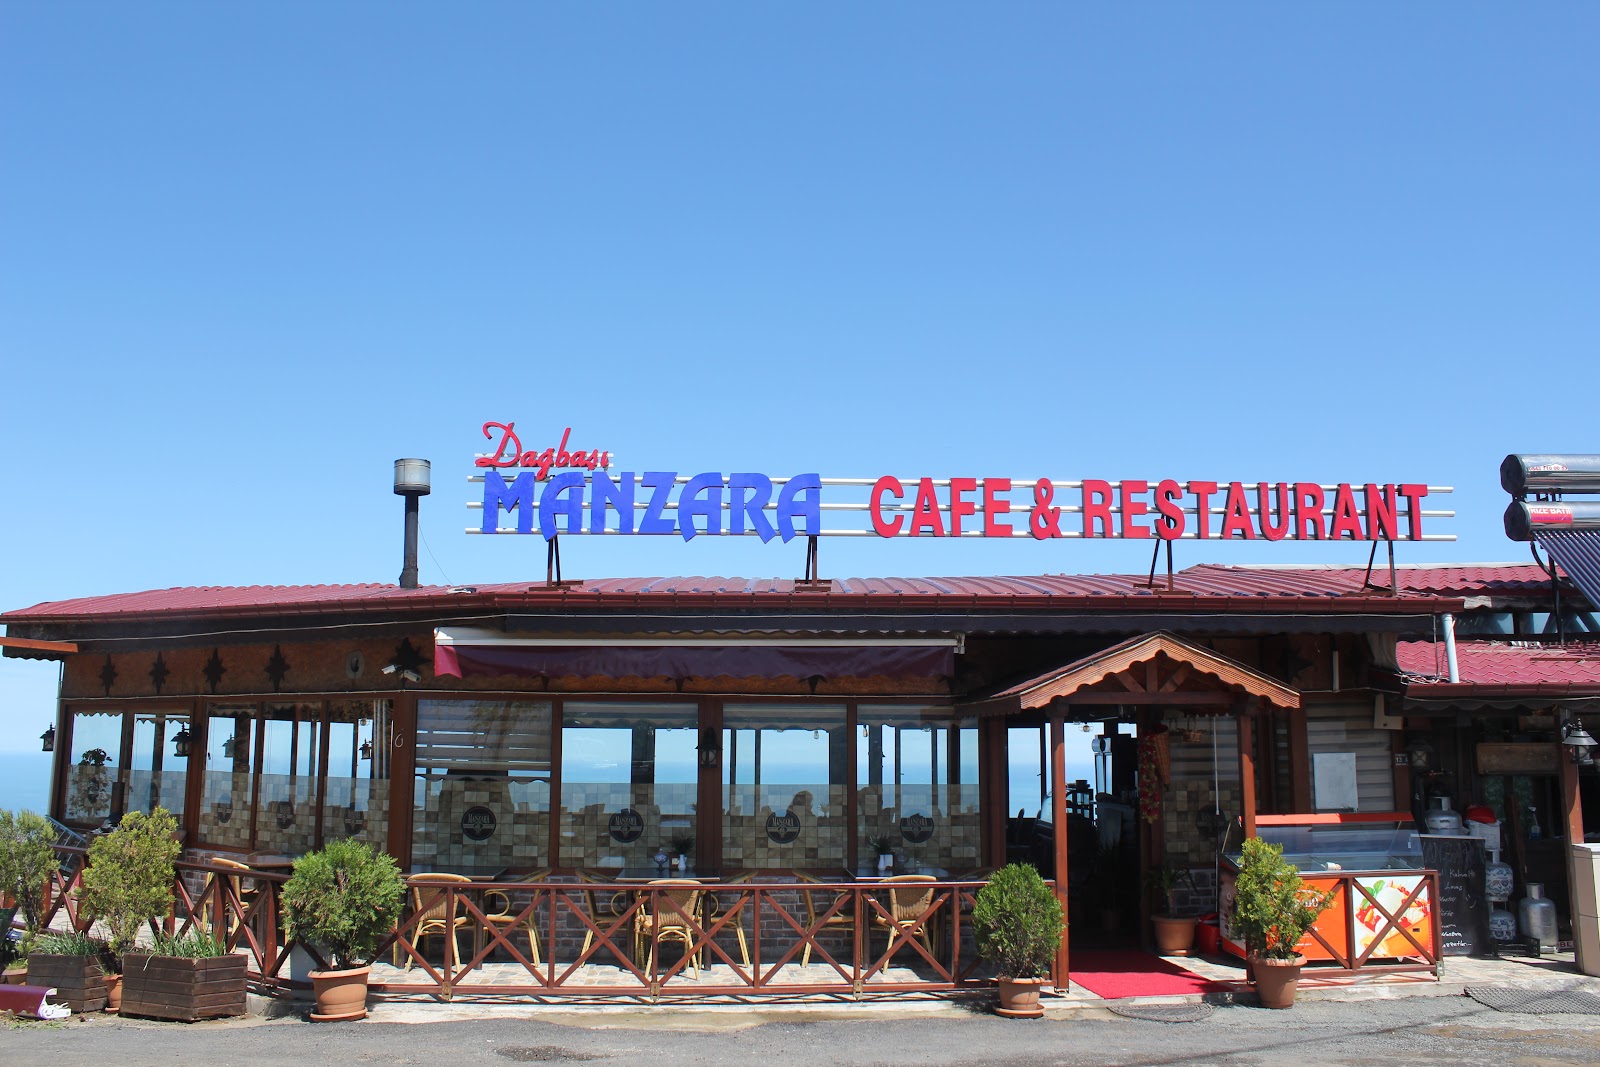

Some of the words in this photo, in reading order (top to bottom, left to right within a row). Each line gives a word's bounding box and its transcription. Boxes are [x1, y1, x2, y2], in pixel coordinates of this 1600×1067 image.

[482, 471, 822, 544] MANZARA
[869, 475, 1013, 538] CAFE
[1028, 477, 1062, 540] &
[1081, 477, 1428, 541] RESTAURANT
